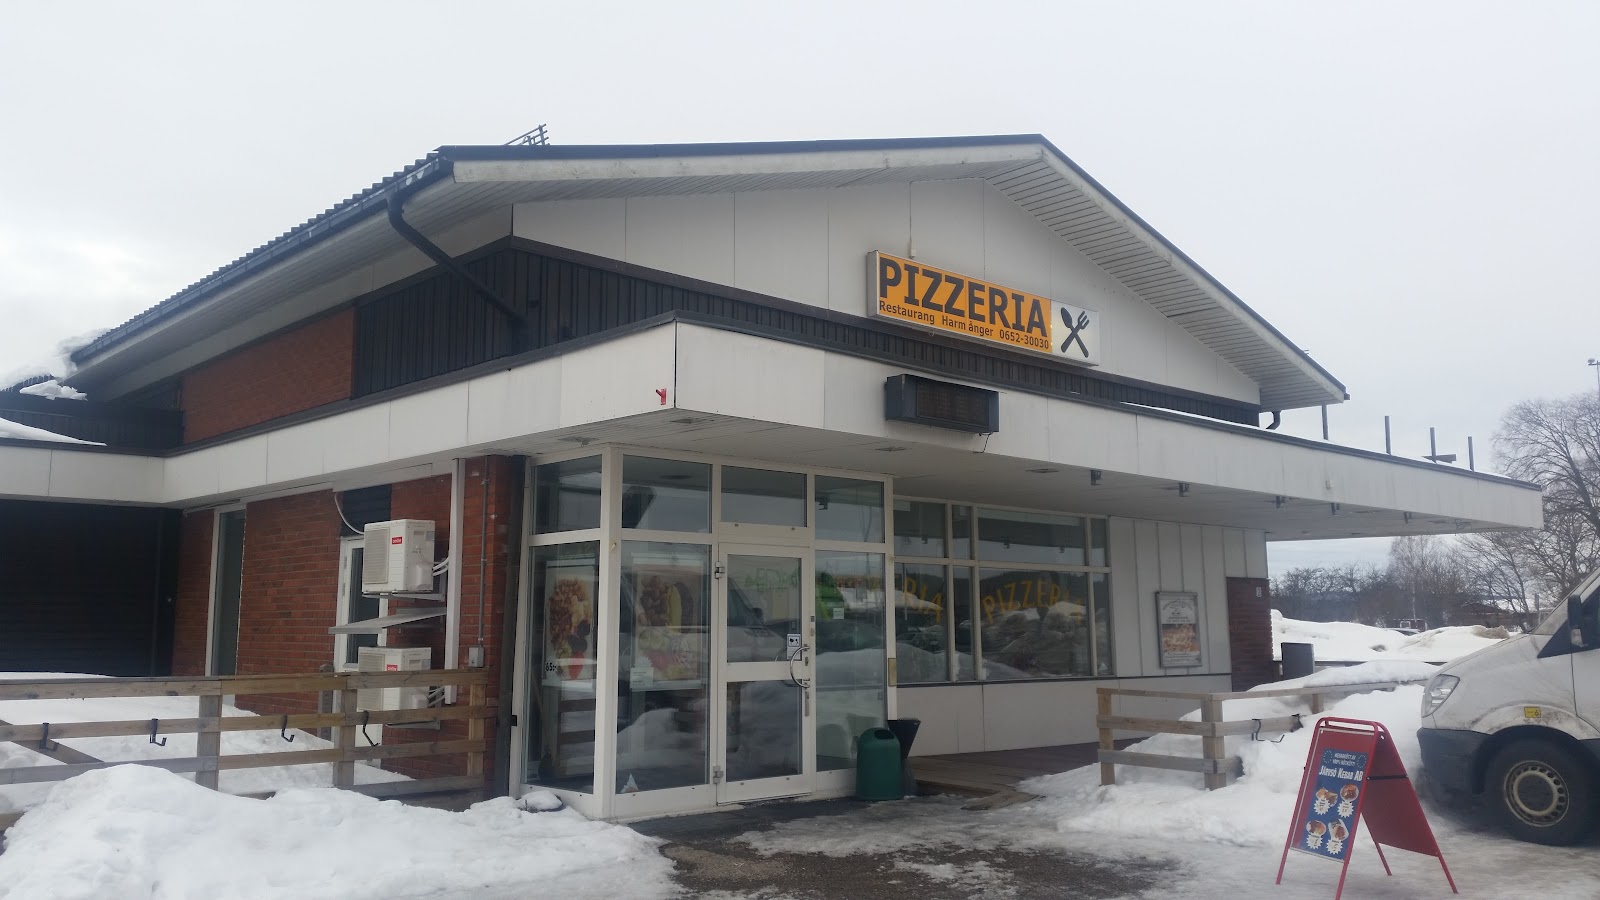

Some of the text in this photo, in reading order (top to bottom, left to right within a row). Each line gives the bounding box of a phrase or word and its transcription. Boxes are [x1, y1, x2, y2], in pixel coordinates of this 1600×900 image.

[879, 256, 1048, 338] PIZZERIA
[879, 300, 935, 325] Restaurang
[999, 329, 1049, 350] 0652-30030
[1354, 770, 1364, 781] AB
